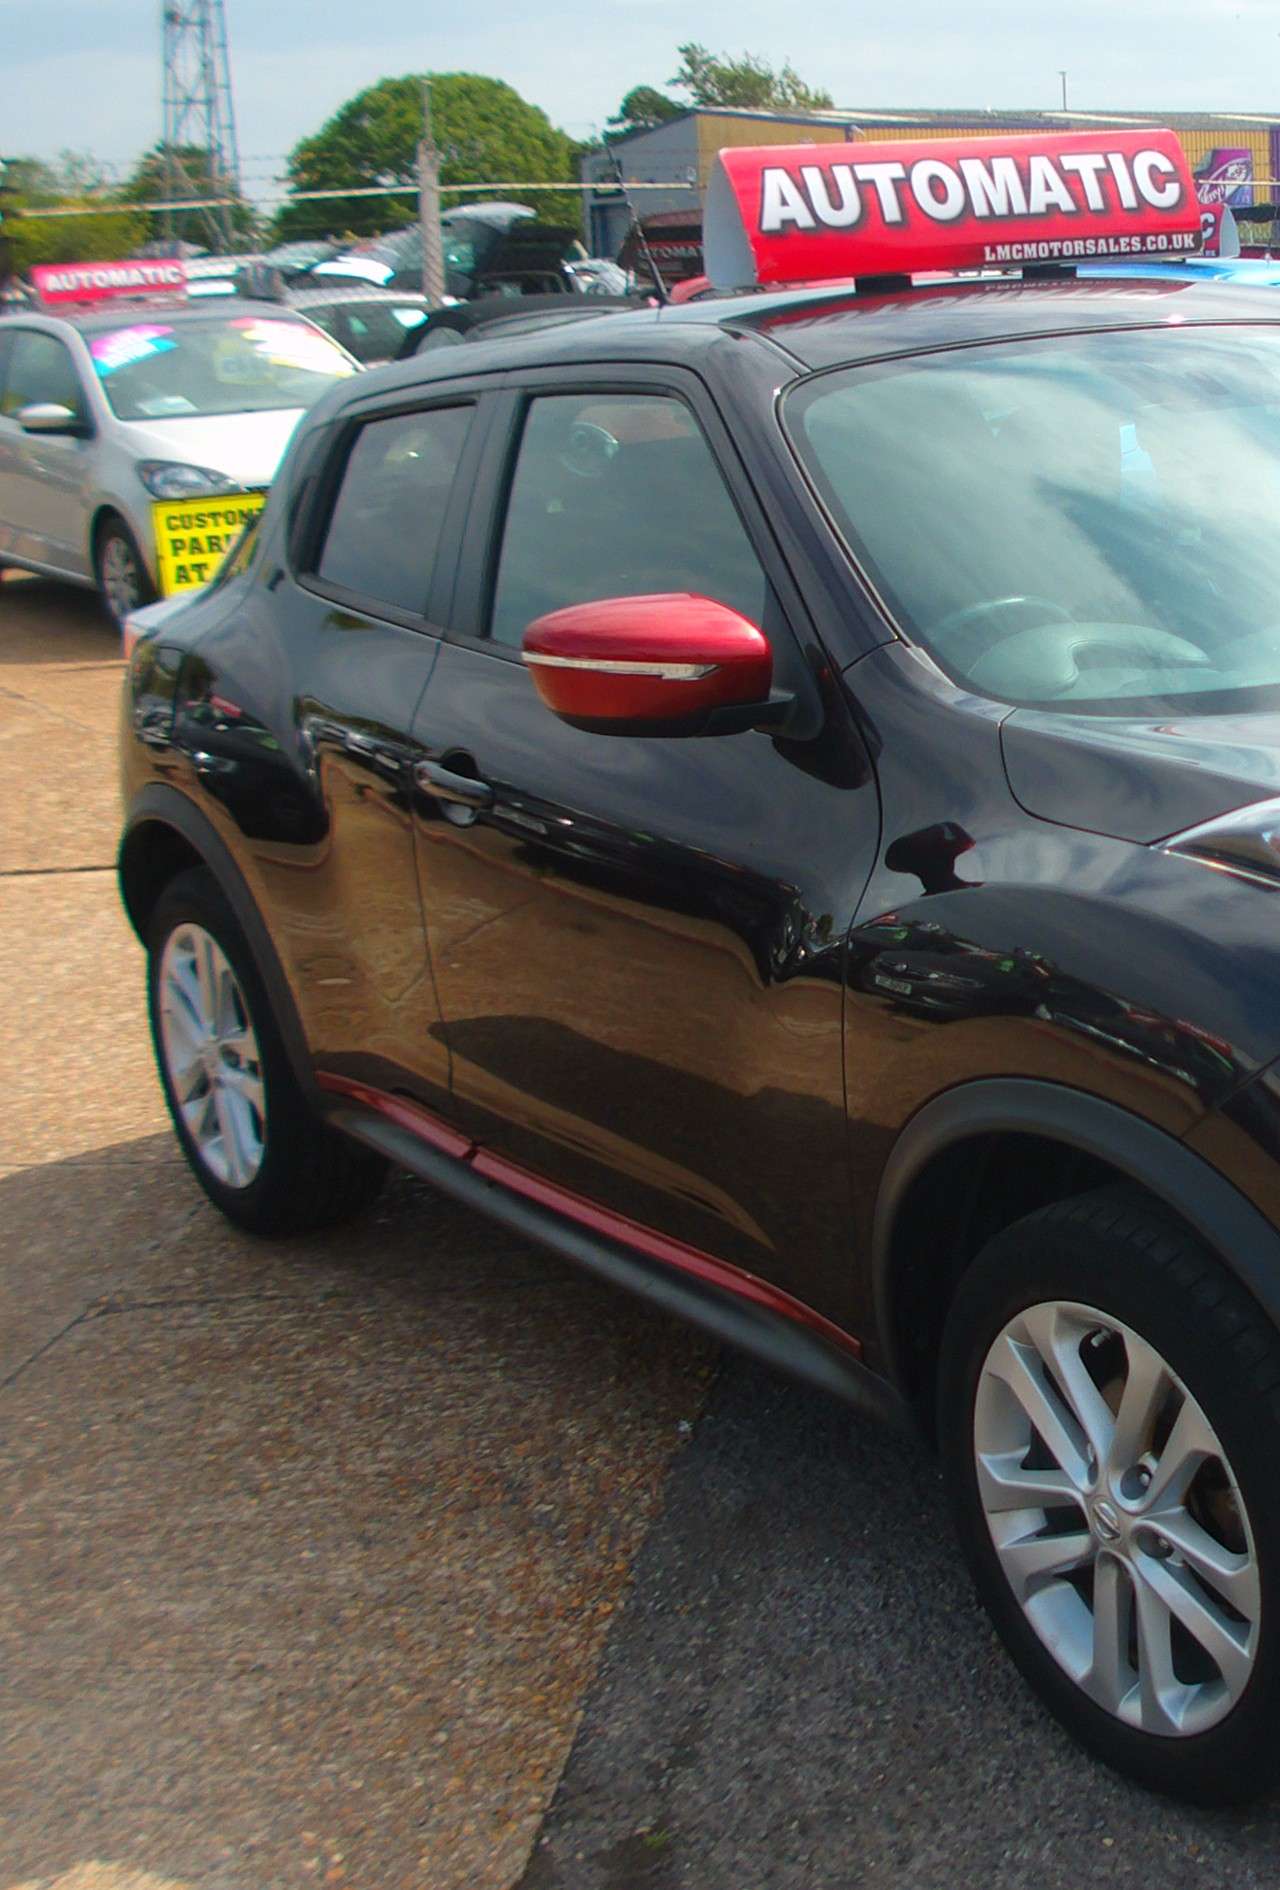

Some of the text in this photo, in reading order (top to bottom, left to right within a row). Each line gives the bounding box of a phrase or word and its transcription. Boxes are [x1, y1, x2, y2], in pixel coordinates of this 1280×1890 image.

[760, 150, 1181, 231] AUTOMATIC
[984, 233, 1196, 262] LMCMOTORSALES.CO.UK
[46, 266, 183, 291] AUTOMATIC
[176, 563, 208, 584] AT
